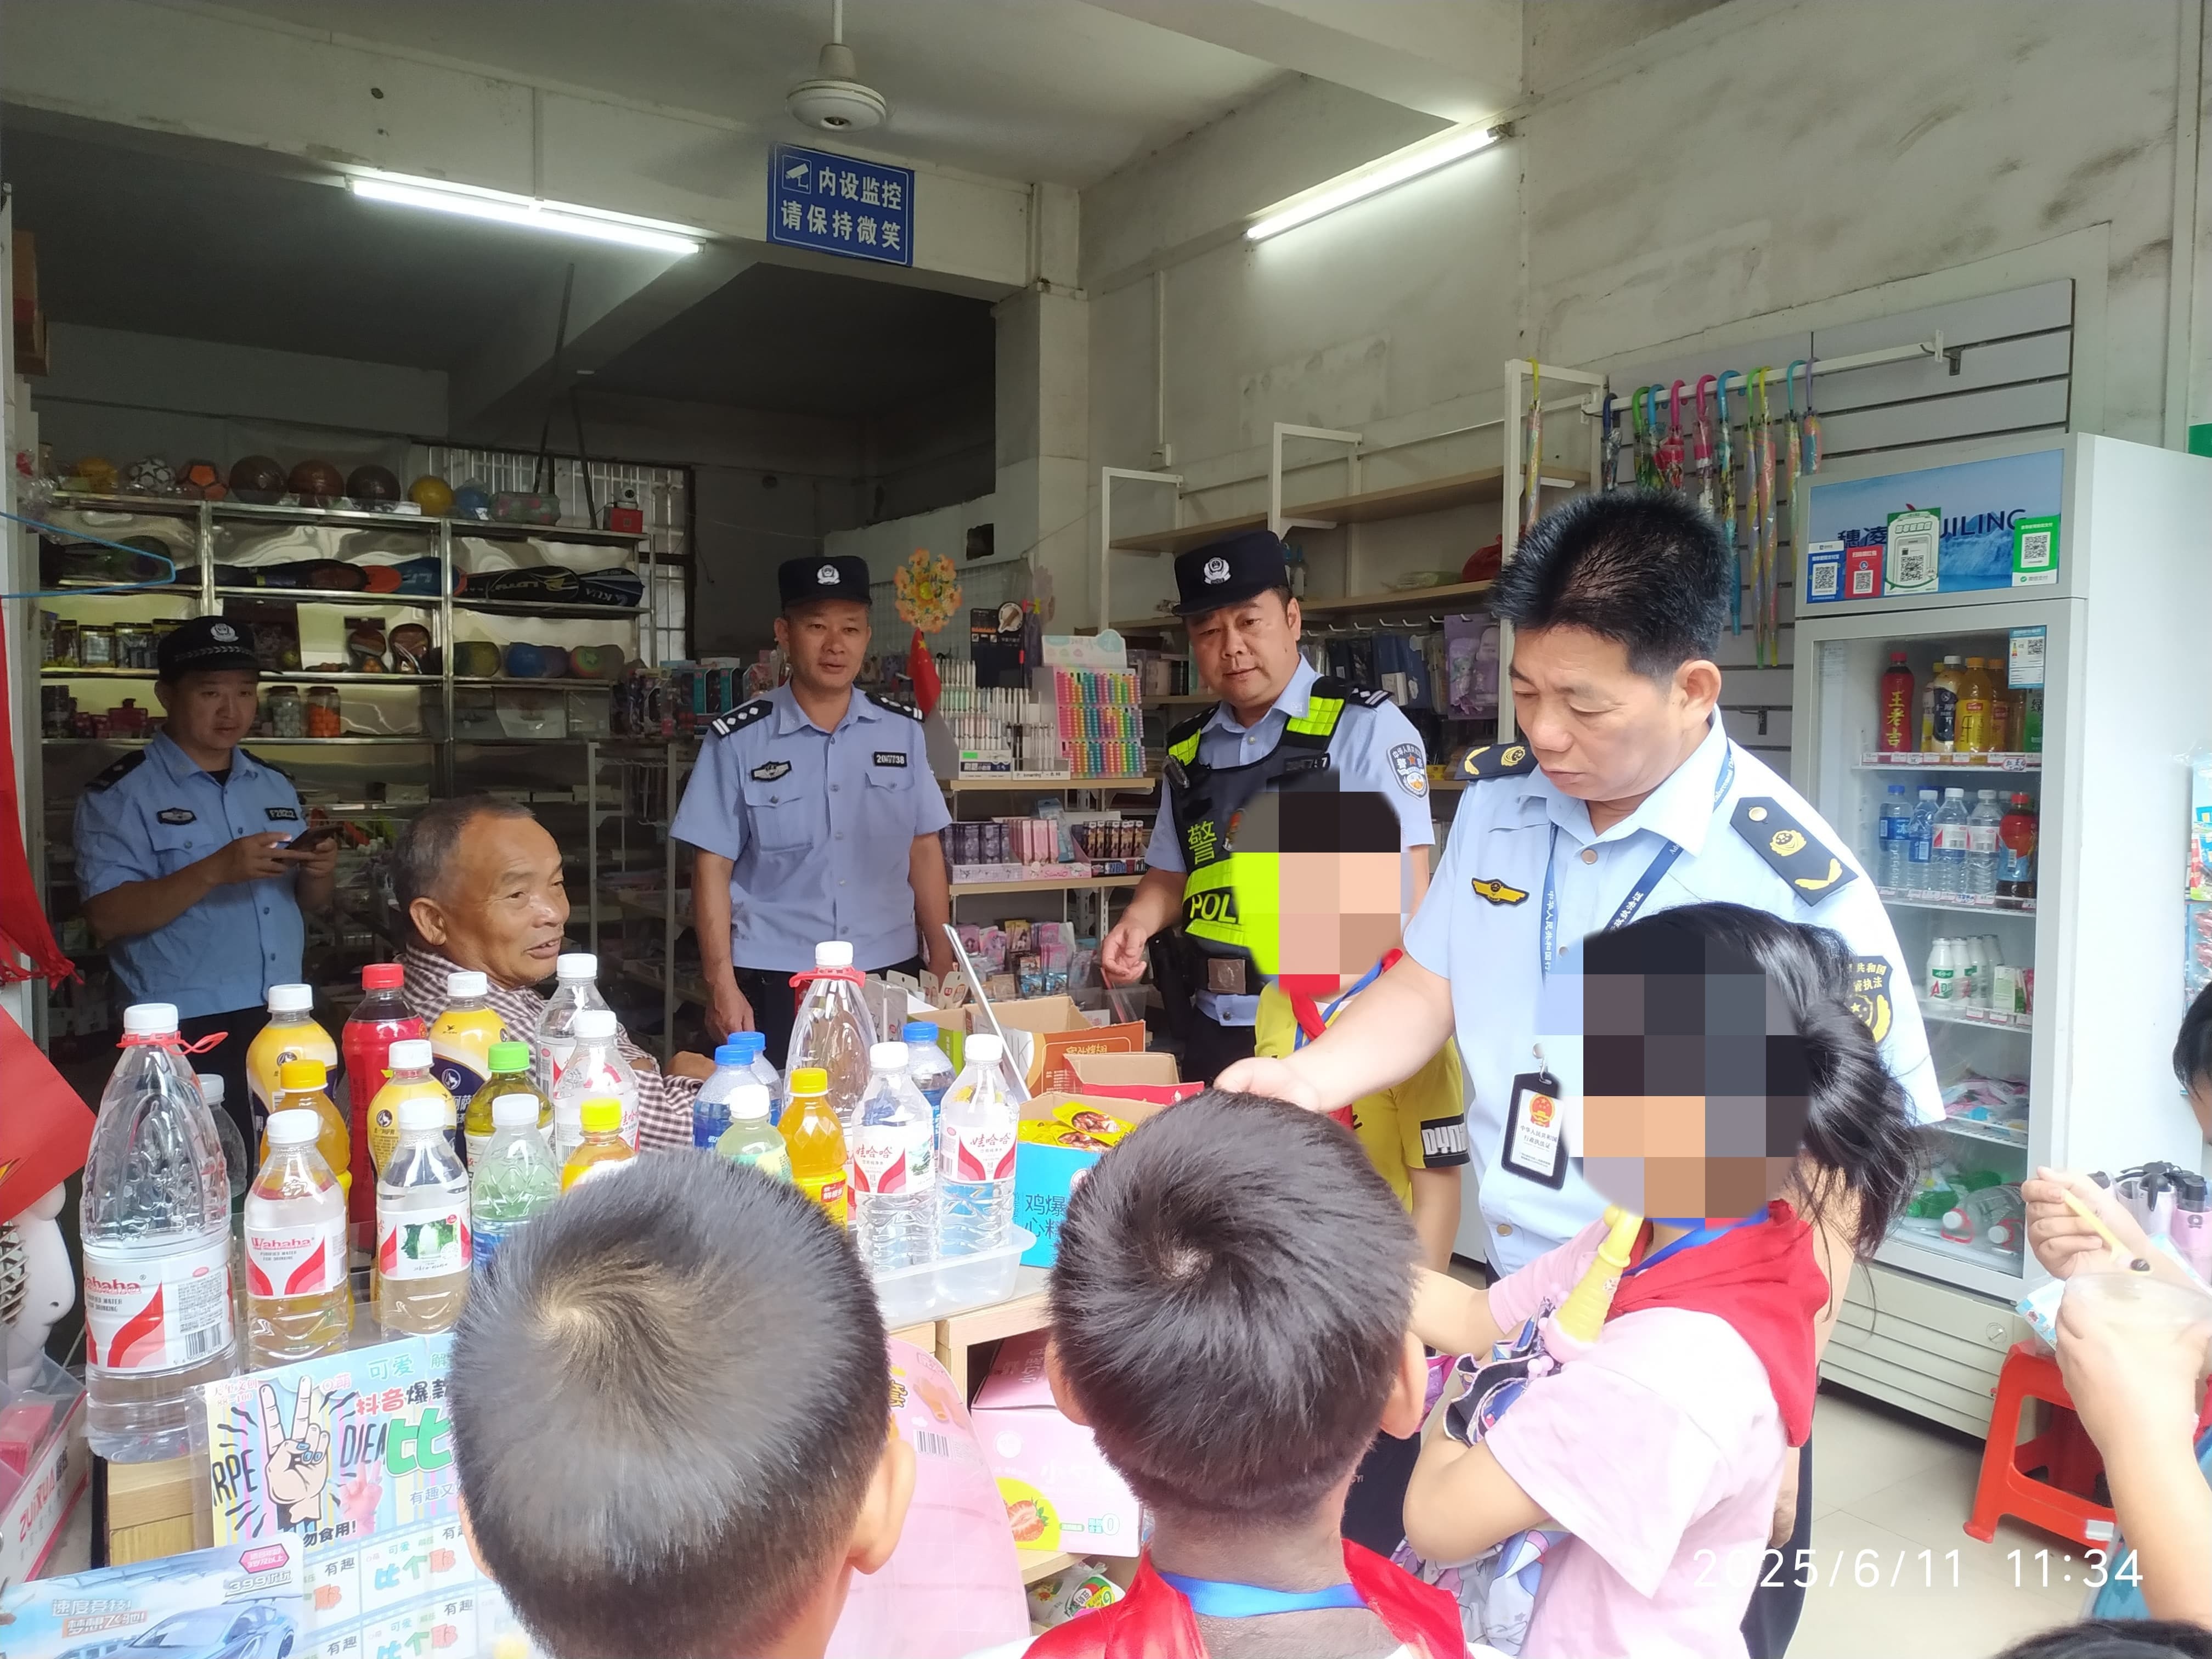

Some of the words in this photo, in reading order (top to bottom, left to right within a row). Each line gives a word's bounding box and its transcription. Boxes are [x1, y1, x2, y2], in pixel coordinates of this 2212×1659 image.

[819, 166, 901, 210] 内设监控
[781, 200, 900, 250] 请保持微笑
[1886, 690, 1904, 747] 王老吉
[1187, 821, 1217, 865] 警
[1109, 863, 1126, 874] NBA
[856, 1144, 893, 1158] 娃哈哈
[970, 1132, 1011, 1147] 娃哈哈
[251, 1237, 311, 1250] Wahaha
[369, 1354, 414, 1380] 可爱
[212, 1449, 258, 1507] RPE
[303, 1520, 357, 1548] 勿食用!
[325, 1557, 356, 1577] 有趣
[374, 1548, 456, 1590] 比个耶
[444, 1599, 473, 1616] 有趣
[327, 1636, 357, 1656] 有趣
